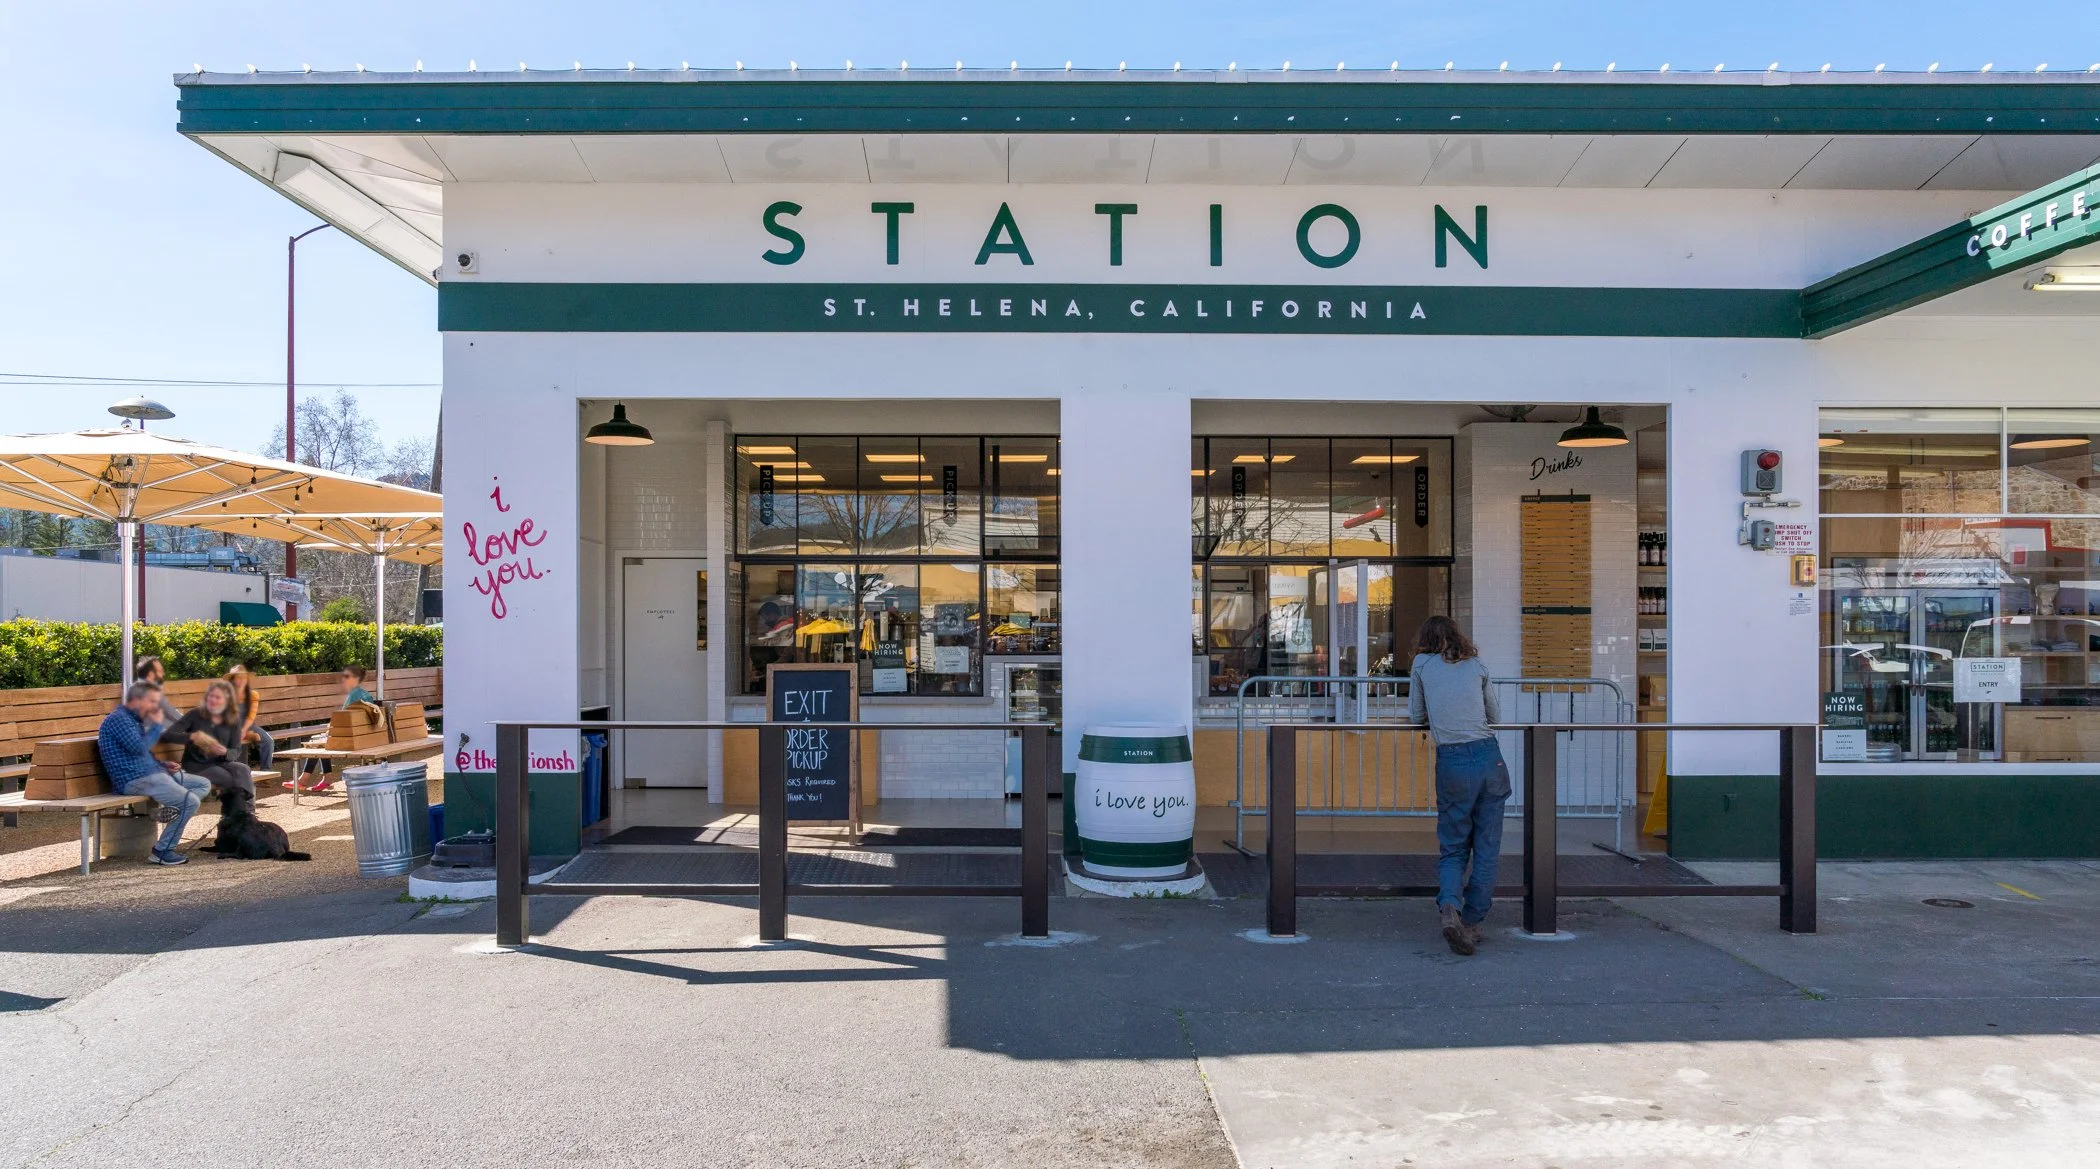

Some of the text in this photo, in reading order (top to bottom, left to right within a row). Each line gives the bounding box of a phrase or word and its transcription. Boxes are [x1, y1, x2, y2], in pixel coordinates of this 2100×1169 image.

[761, 200, 1488, 270] STATION
[823, 298, 1427, 319] ST. HELENA, CALIFORNIA
[1529, 450, 1583, 480] Drinks
[489, 476, 511, 512] i
[1235, 473, 1243, 516] ORDER
[1418, 473, 1426, 517] ORDER
[463, 518, 547, 566] love
[784, 689, 833, 715] EXIT
[1825, 704, 1863, 712] HIRING
[1831, 696, 1856, 704] NOW
[1095, 788, 1101, 807] i
[1107, 791, 1146, 810] love
